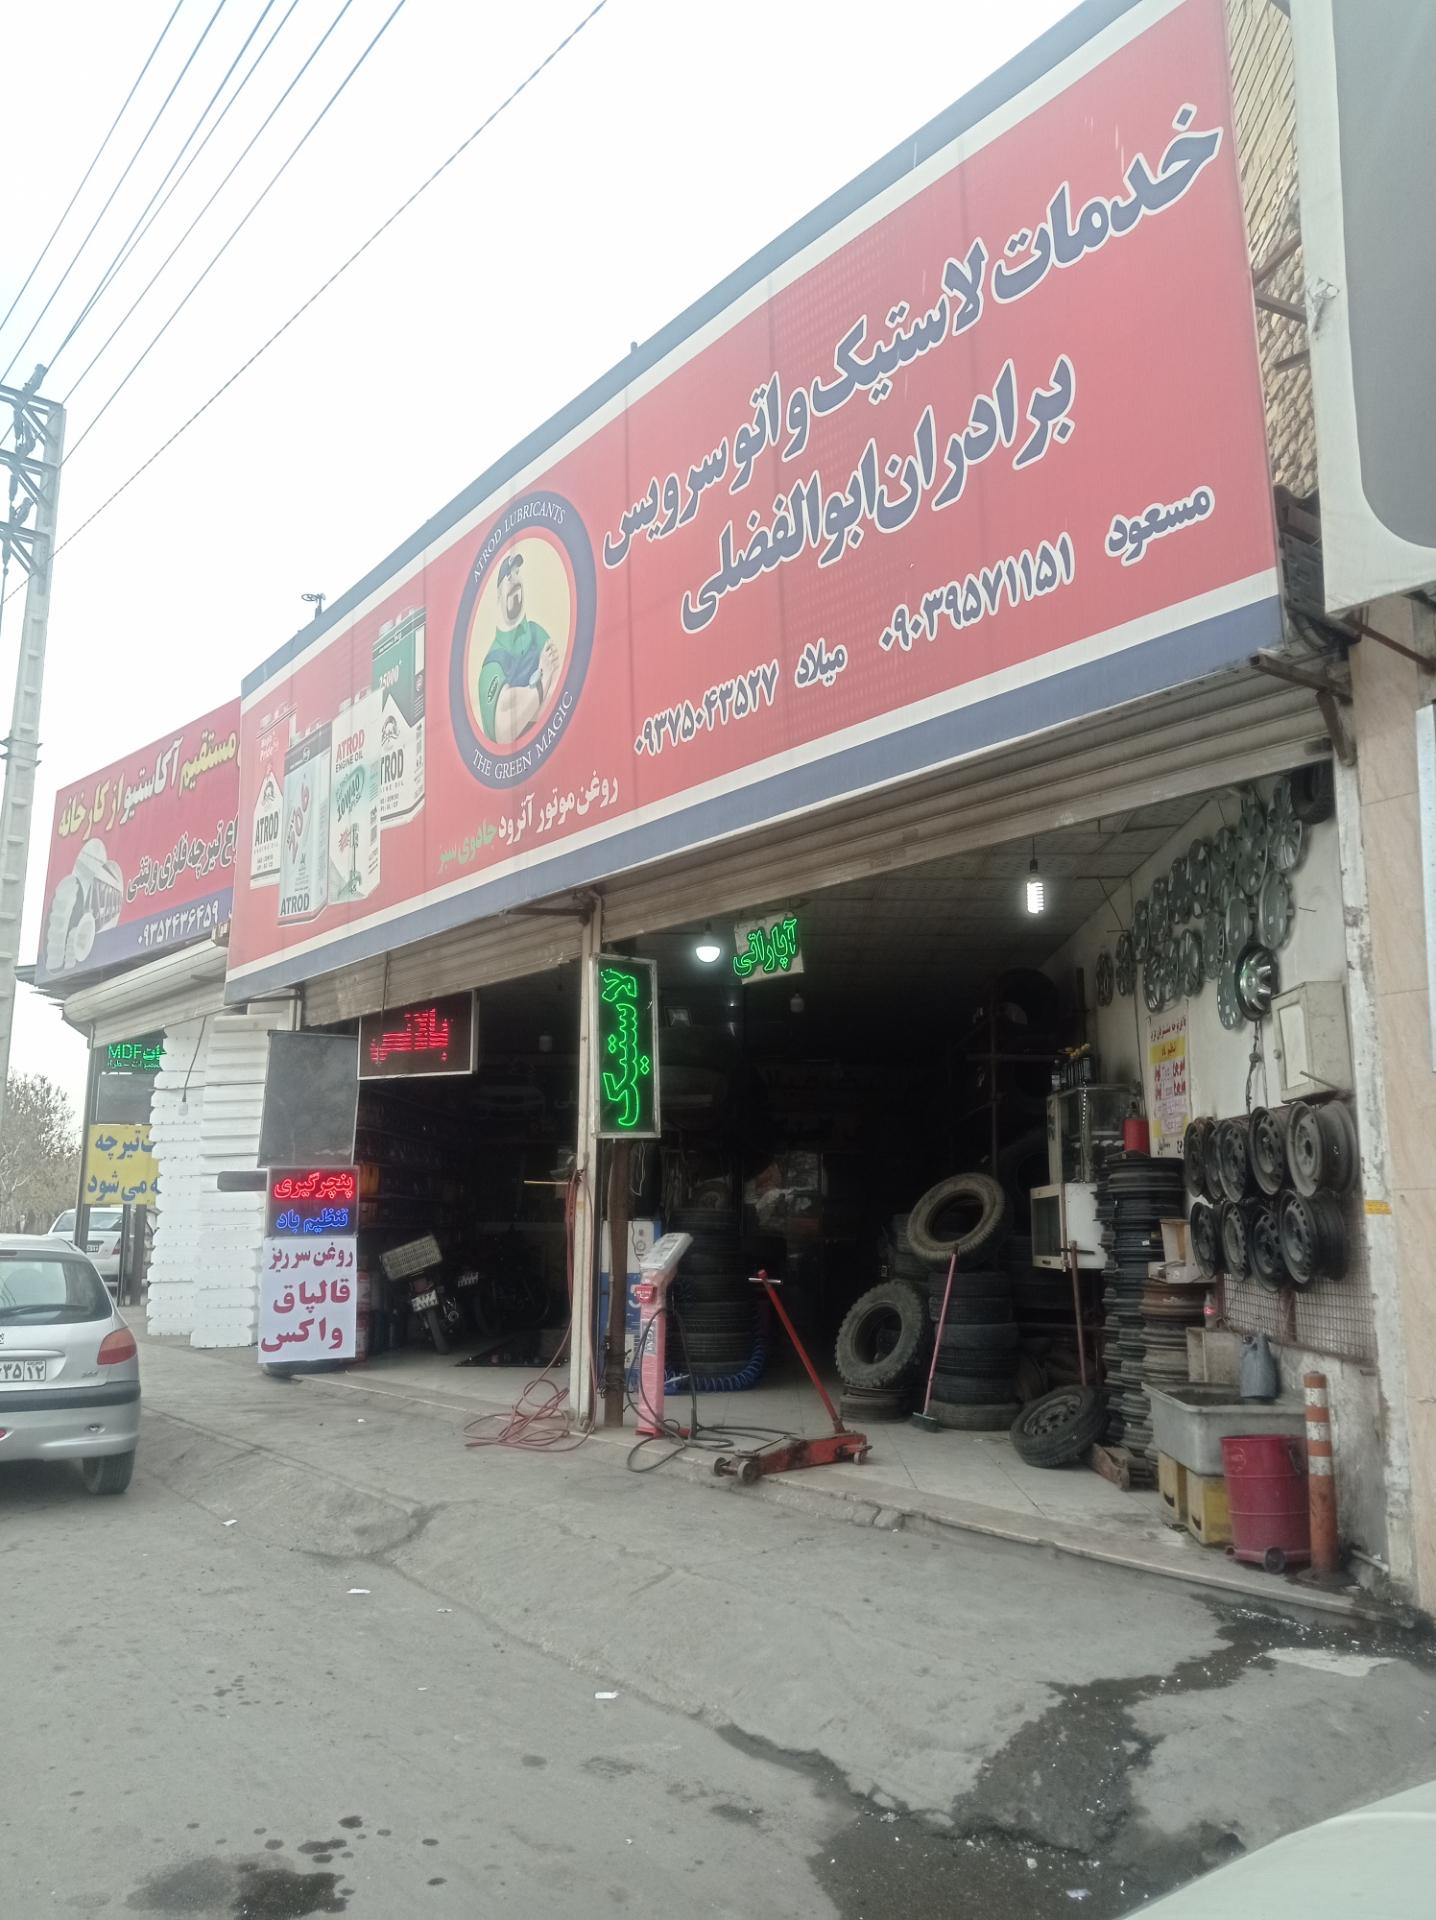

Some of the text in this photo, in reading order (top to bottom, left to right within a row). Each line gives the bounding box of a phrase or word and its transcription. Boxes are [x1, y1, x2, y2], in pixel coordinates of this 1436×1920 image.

[991, 104, 1223, 302] خدمات
[810, 238, 989, 417] لاستیک
[782, 386, 810, 462] و
[681, 355, 1075, 632] برادران ابوالفضلی
[473, 501, 566, 583] ATROD LUBRICANTS
[879, 487, 1214, 652] مسعود ۰۹۰۳۹۵۷۱۱۵۱
[634, 638, 847, 756] میلاد ۰۹۳۷۵۰۴۳۵۲۷
[336, 729, 365, 763] ATROD
[354, 752, 364, 763] OIL
[472, 691, 573, 779] THE GREEN MAGIC
[179, 730, 237, 798] مستقیم
[380, 747, 404, 786] TROD
[536, 788, 575, 833] موتور
[576, 770, 619, 816] روغن
[254, 810, 279, 847] ATROD
[498, 792, 535, 846] آترود
[157, 831, 189, 891] فلزی
[186, 819, 224, 880] تیرچه
[280, 893, 310, 916] ATROD
[733, 918, 798, 976] آپاراتی
[108, 1043, 143, 1060] MDF
[95, 1129, 141, 1160] تیرچه
[88, 1170, 120, 1201] شود
[274, 1172, 353, 1198] پنچرگیری
[276, 1207, 349, 1233] تنظیم باد
[313, 1242, 353, 1267] روغن
[273, 1278, 351, 1314] قالپاق
[0, 1363, 23, 1380] ۳۵
